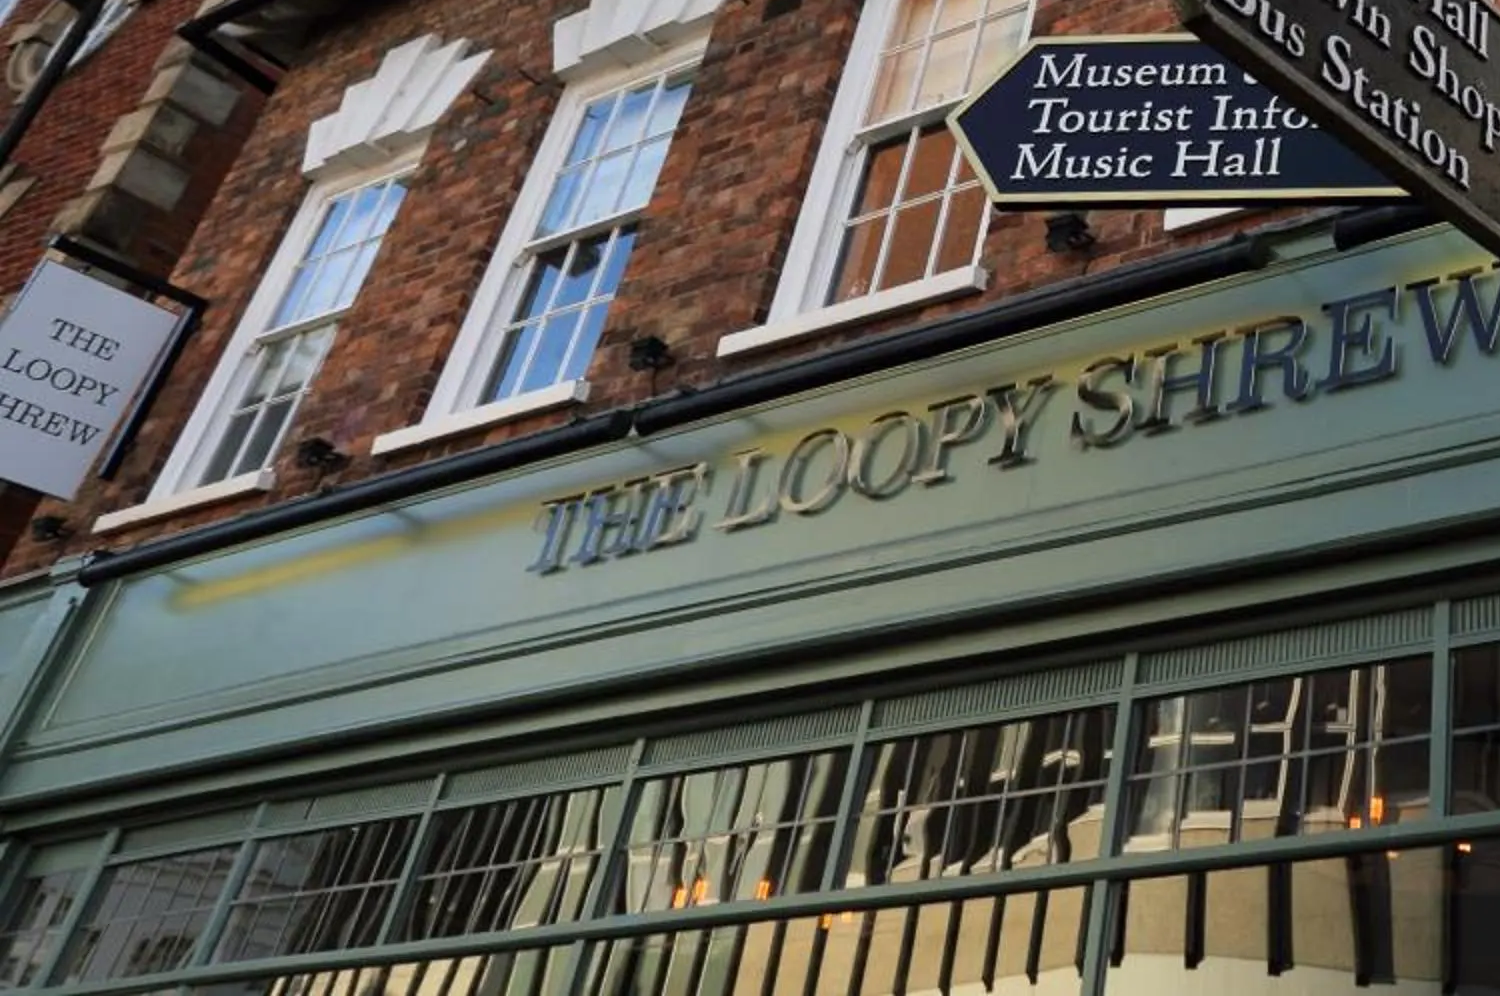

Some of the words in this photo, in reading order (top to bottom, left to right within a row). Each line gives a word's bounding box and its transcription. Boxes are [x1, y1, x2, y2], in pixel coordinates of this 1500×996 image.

[1033, 53, 1227, 88] Museum
[1027, 98, 1192, 133] Tourist
[1208, 95, 1319, 131] Info
[1322, 34, 1470, 189] Station
[1010, 143, 1153, 180] Music
[1170, 137, 1281, 177] Hall
[50, 318, 120, 361] THE
[1, 348, 119, 406] LOOPY
[0, 392, 102, 445] HREW
[526, 462, 712, 575] THE
[712, 373, 1054, 533] LOOPY
